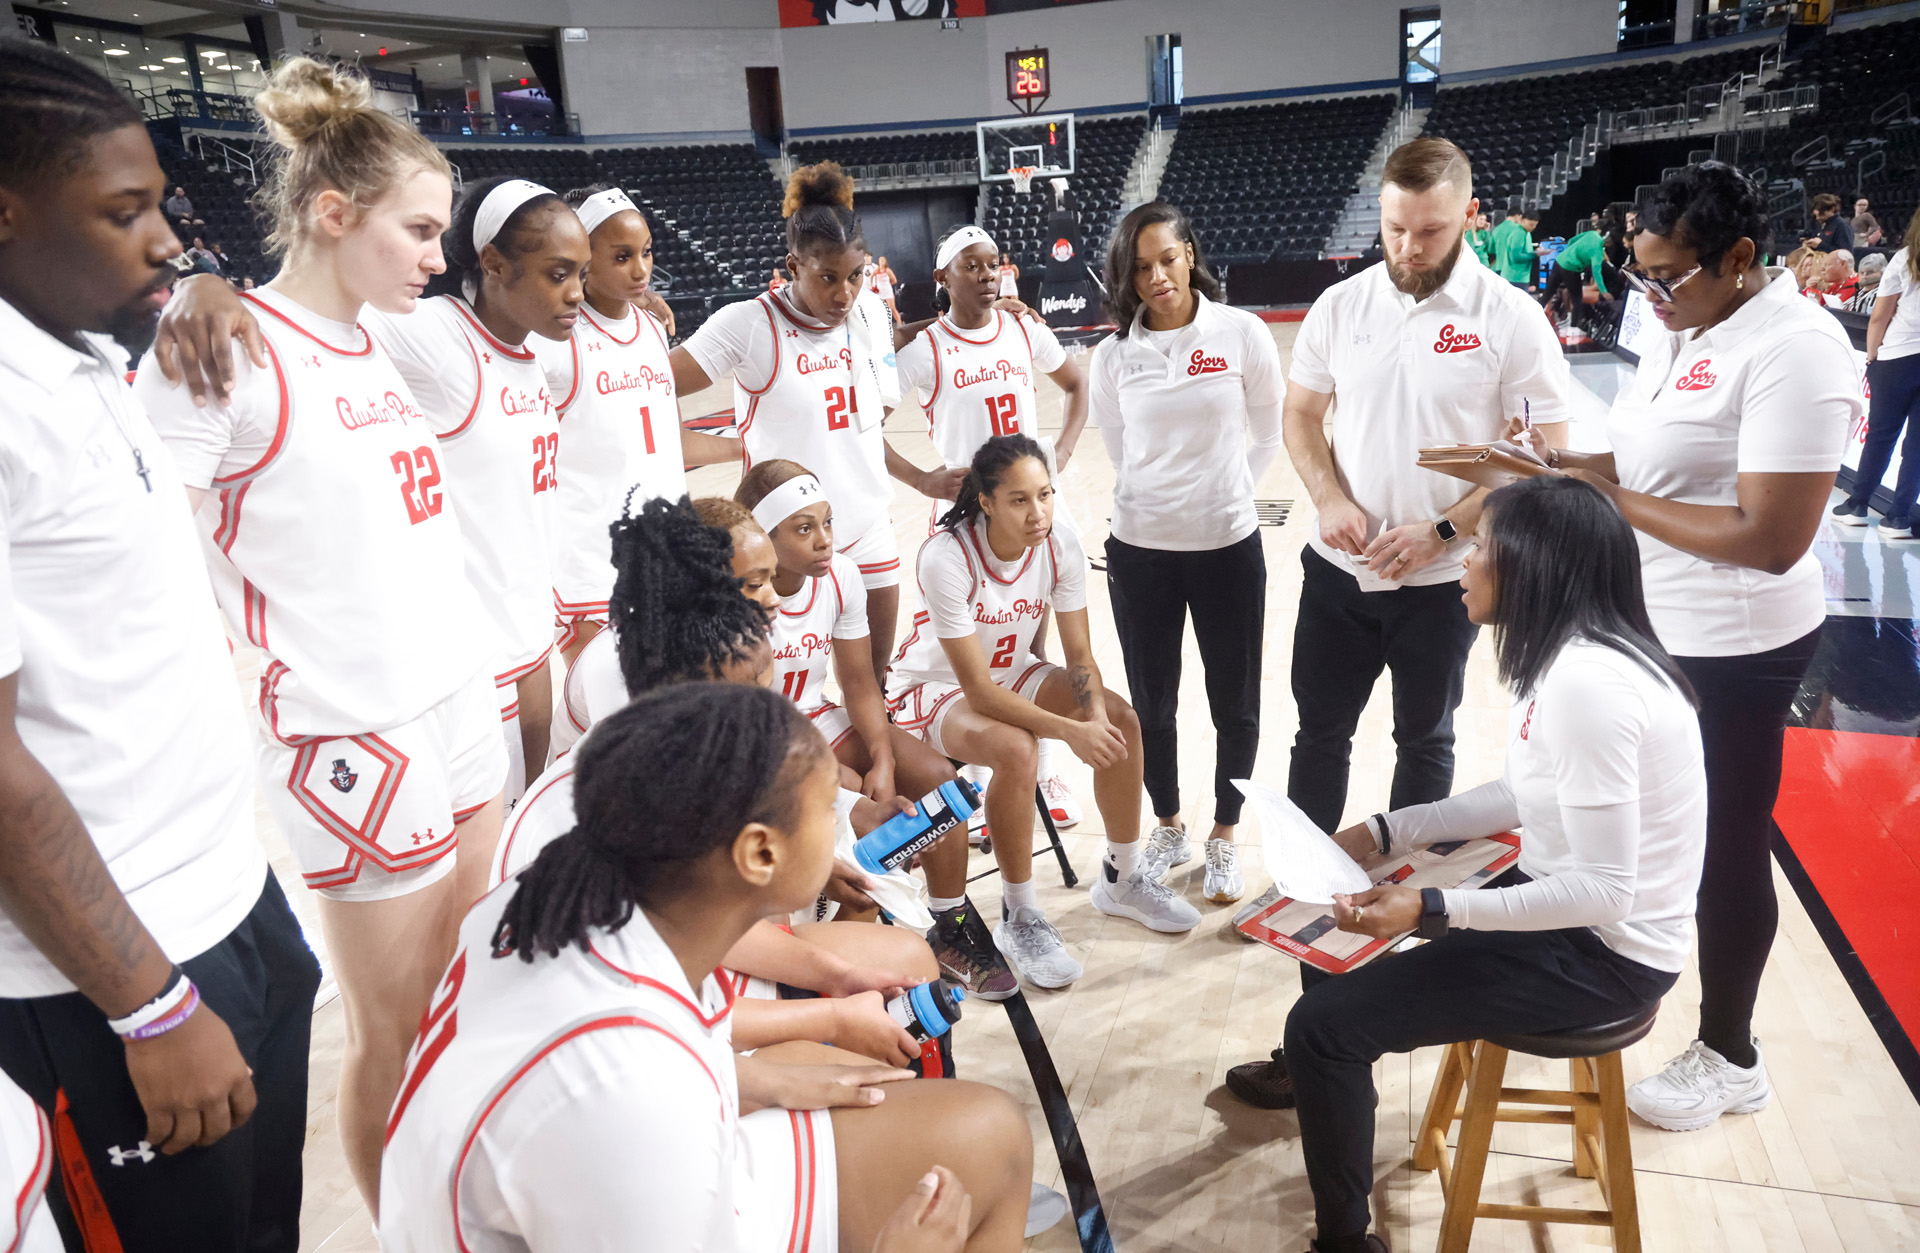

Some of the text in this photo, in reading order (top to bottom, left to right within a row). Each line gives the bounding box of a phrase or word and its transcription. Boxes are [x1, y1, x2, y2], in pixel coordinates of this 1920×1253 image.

[1016, 71, 1042, 95] 26
[1041, 293, 1087, 315] Wendy's
[1433, 324, 1482, 353] Govs
[797, 353, 842, 375] Austin
[954, 359, 1028, 389] Austin Peay
[1187, 349, 1228, 376] Govs
[596, 365, 672, 396] Austin Peay
[335, 396, 396, 431] Austin
[984, 393, 1019, 436] 12
[640, 406, 656, 454] 1
[389, 445, 443, 526] 22
[989, 634, 1017, 668] 2
[782, 669, 809, 702] 11
[884, 816, 959, 869] POWERADE
